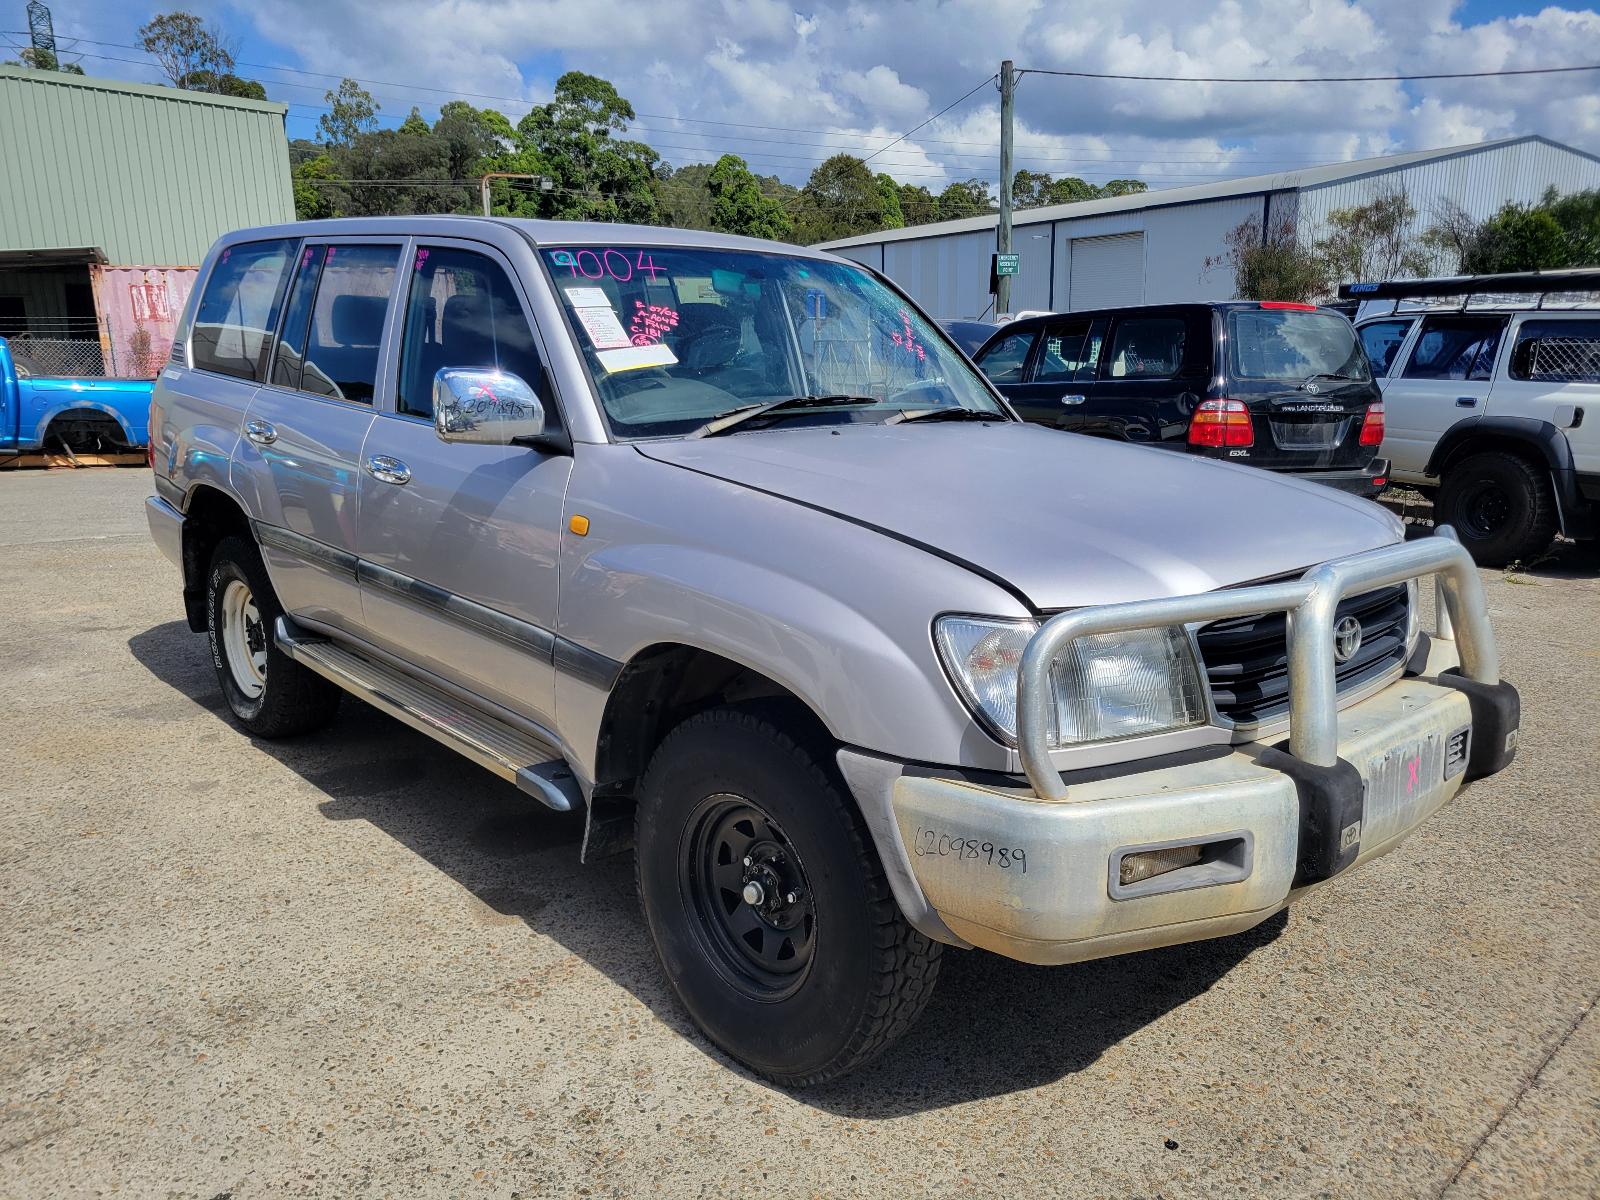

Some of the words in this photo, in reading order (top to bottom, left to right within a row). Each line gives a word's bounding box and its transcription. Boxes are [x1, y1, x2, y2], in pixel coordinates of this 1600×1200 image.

[552, 250, 667, 282] 9004
[1350, 283, 1379, 292] KINGS
[914, 826, 1027, 874] 62098989
